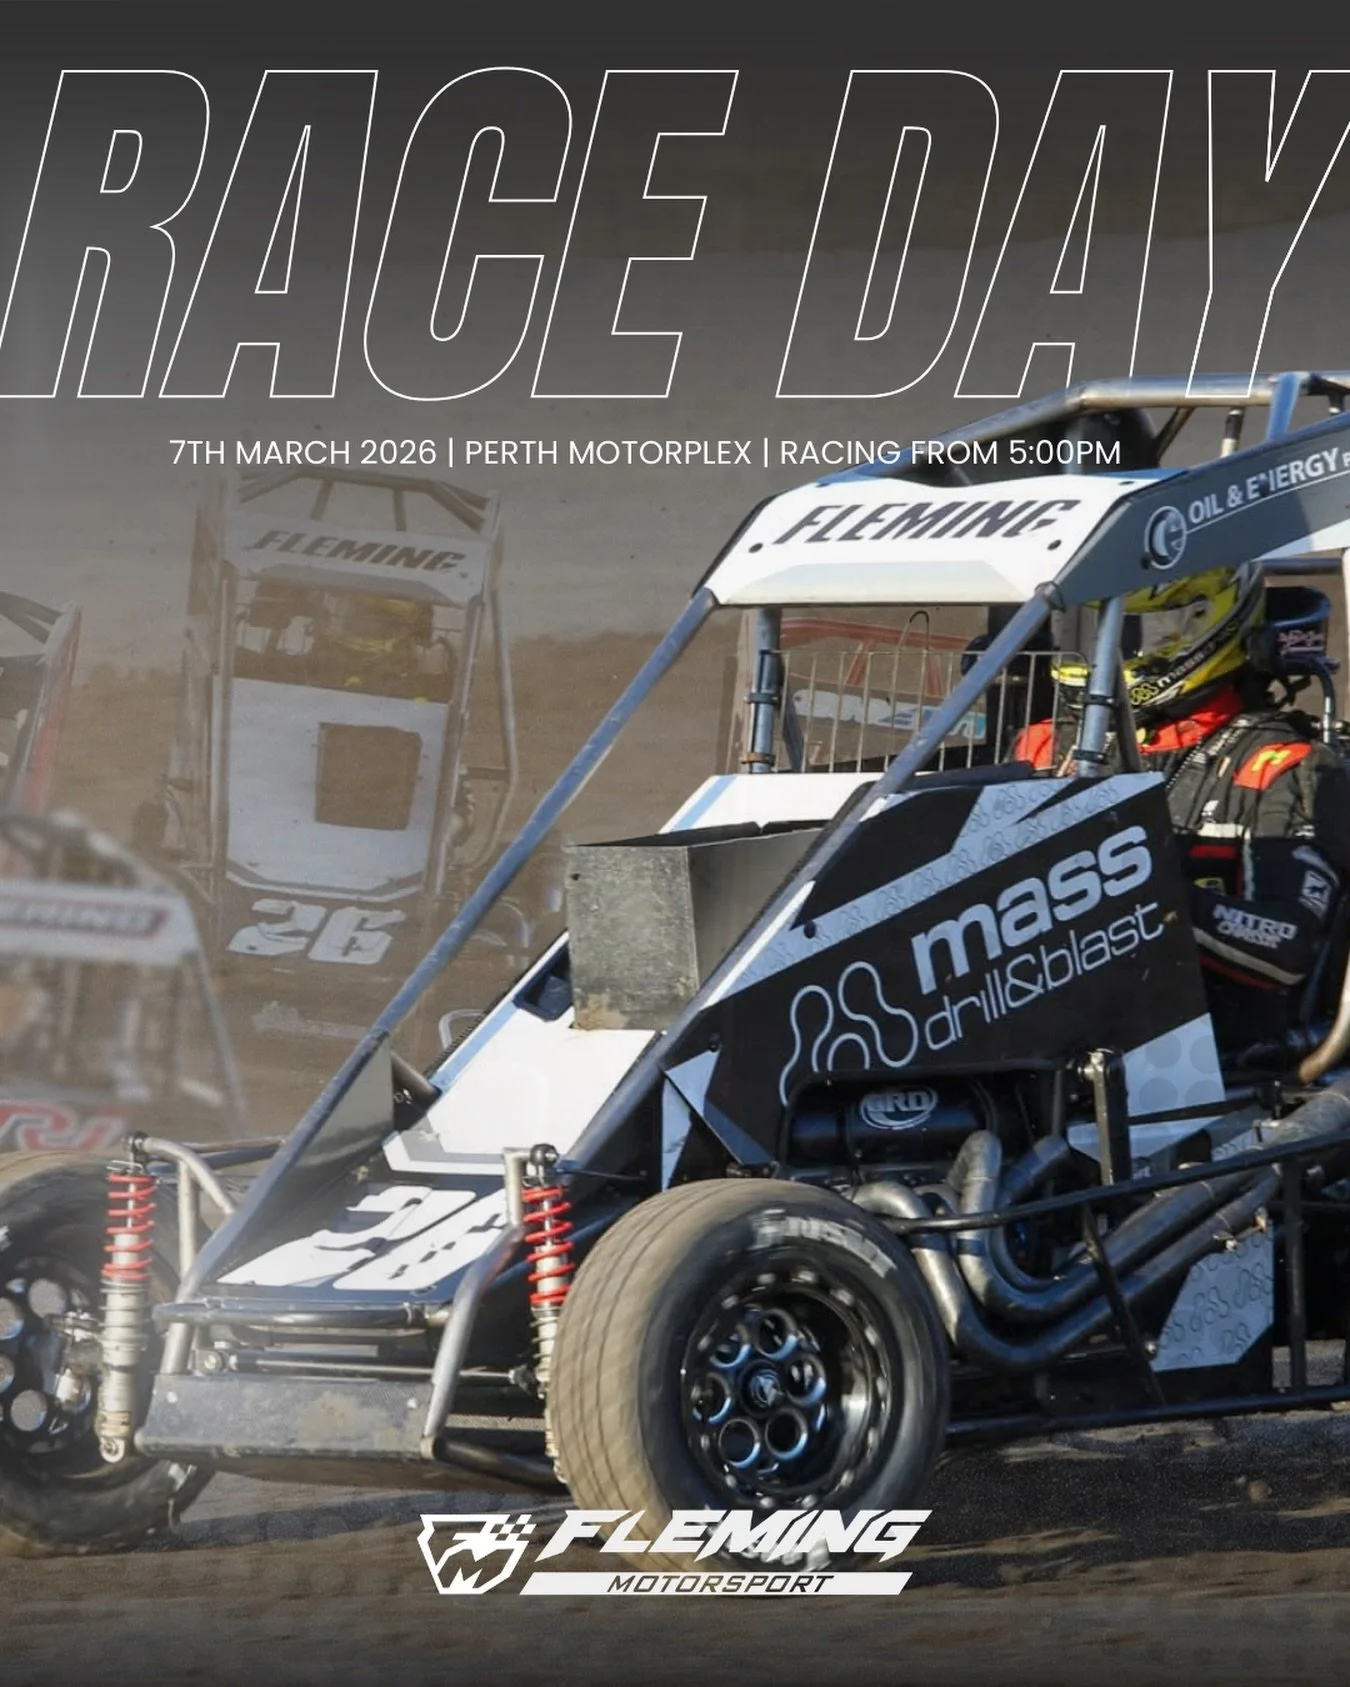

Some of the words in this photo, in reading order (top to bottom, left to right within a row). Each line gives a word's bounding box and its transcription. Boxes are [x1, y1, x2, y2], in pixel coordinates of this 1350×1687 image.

[772, 500, 1081, 545] FLEMING
[1188, 493, 1224, 524] OIL
[1227, 484, 1244, 508] &
[246, 530, 466, 572] FLEMING
[228, 898, 406, 965] 26
[911, 825, 1152, 995] mass
[925, 902, 1164, 1050] drill&blast
